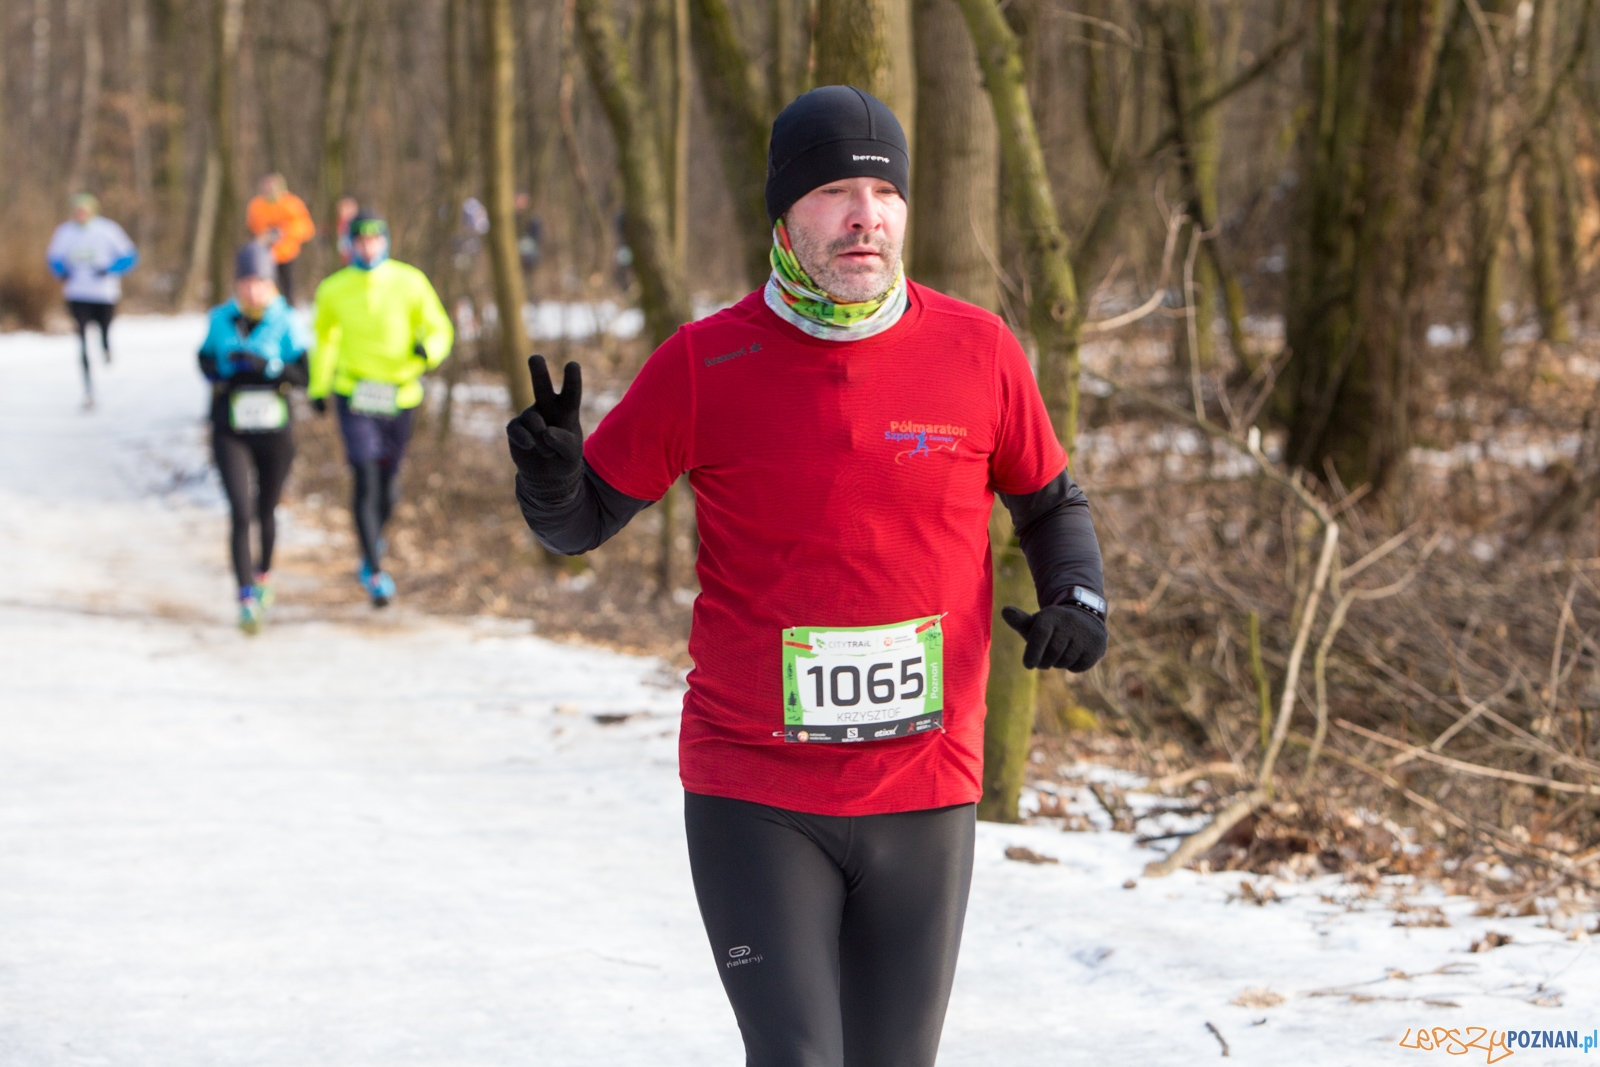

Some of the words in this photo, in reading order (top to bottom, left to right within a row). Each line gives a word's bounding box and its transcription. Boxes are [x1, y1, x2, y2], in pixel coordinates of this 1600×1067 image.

[884, 430, 915, 442] Szpot
[889, 420, 967, 437] Półmaraton
[807, 656, 924, 708] 1065
[929, 661, 939, 700] Poznań
[836, 707, 902, 723] KRZYSZTOF
